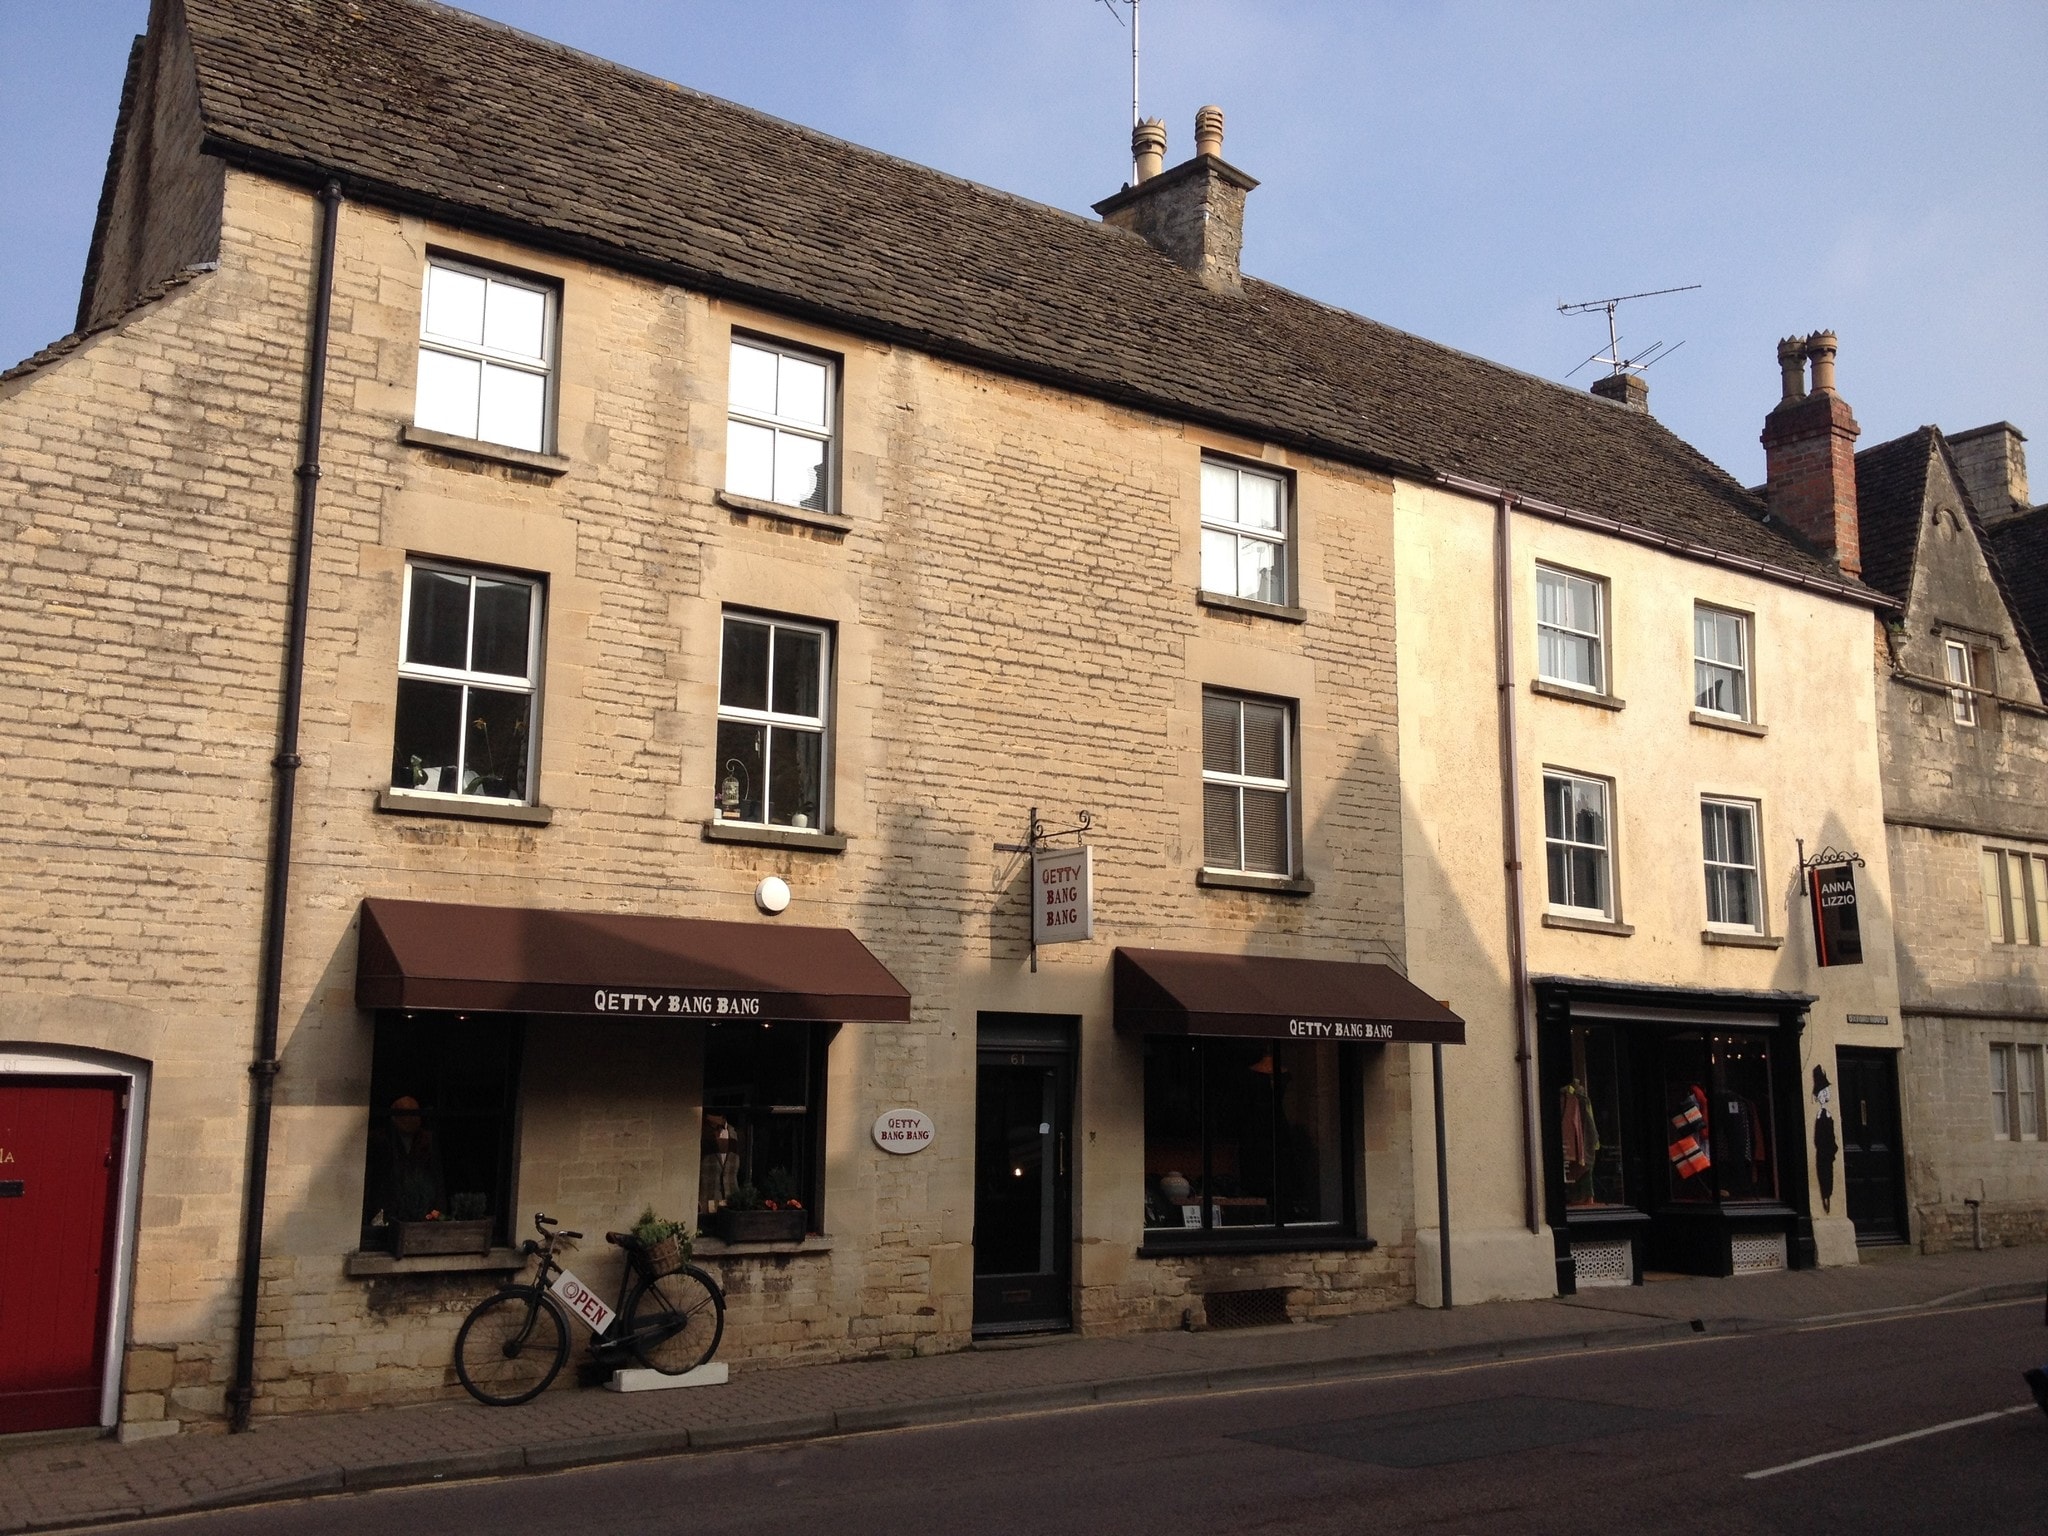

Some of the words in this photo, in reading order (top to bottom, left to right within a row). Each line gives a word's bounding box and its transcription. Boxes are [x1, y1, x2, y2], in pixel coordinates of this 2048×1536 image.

[1047, 887, 1077, 904] BANG
[1822, 881, 1853, 893] ANNA
[1822, 895, 1855, 906] LIZZIO
[1047, 909, 1077, 926] BANG
[595, 990, 663, 1011] QETTY
[668, 995, 712, 1013] BANG
[717, 997, 759, 1014] BANG
[1290, 1019, 1332, 1036] QETTY
[1335, 1023, 1362, 1037] BANG
[1365, 1024, 1392, 1038] BANG
[1010, 1054, 1025, 1065] 61
[881, 1132, 904, 1140] BANG
[907, 1131, 929, 1139] BANG
[562, 1282, 607, 1325] OPEN
